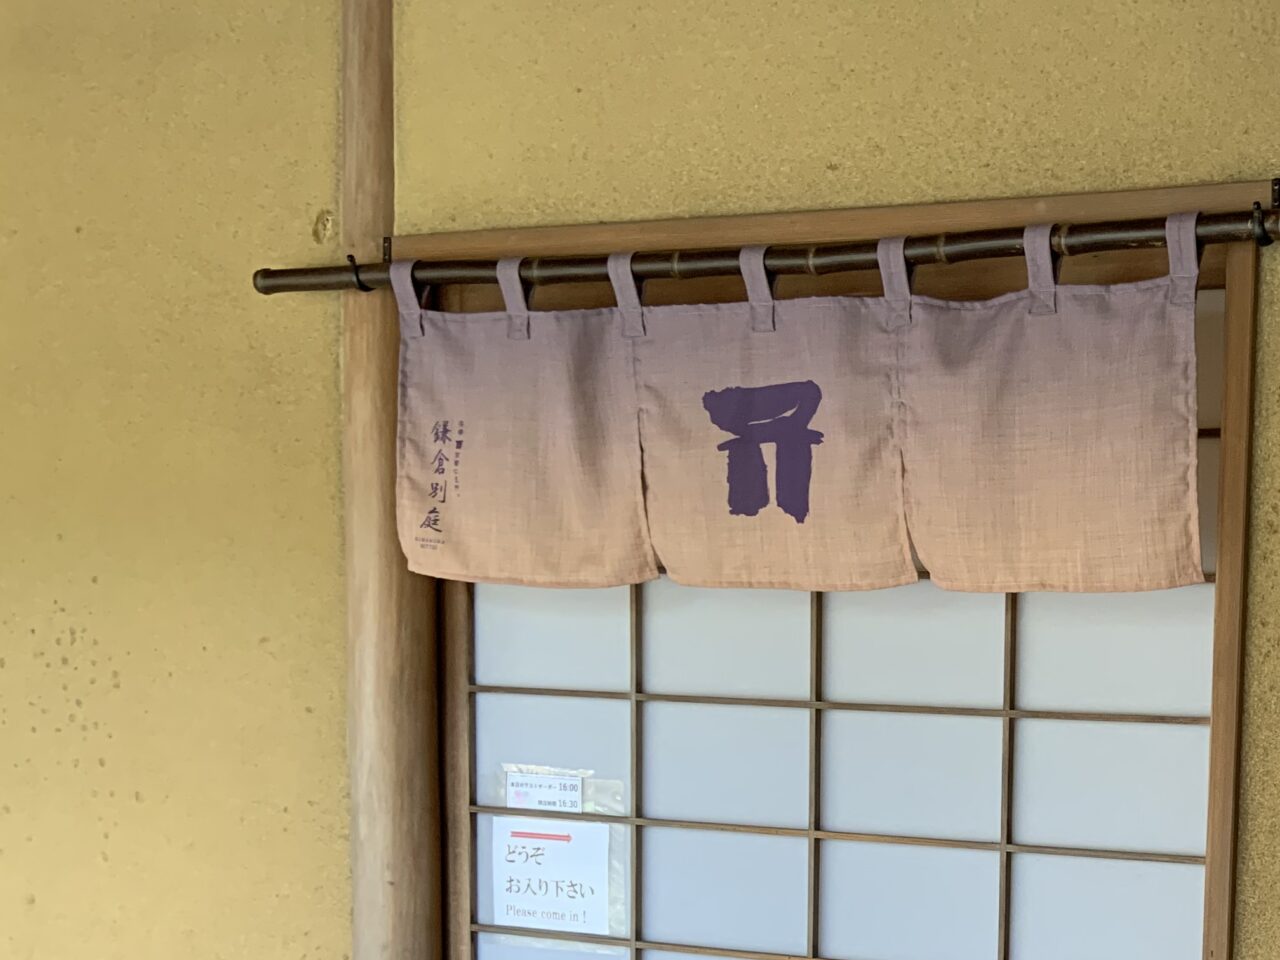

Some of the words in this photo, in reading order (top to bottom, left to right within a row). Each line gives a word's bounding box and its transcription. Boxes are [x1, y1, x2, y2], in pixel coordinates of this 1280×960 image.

[419, 420, 453, 533] 鎌倉別庭
[558, 783, 579, 793] 16:00
[505, 844, 546, 865] どうぞ
[505, 876, 595, 899] お入り下さい
[506, 904, 538, 918] Please
[541, 907, 566, 921] come
